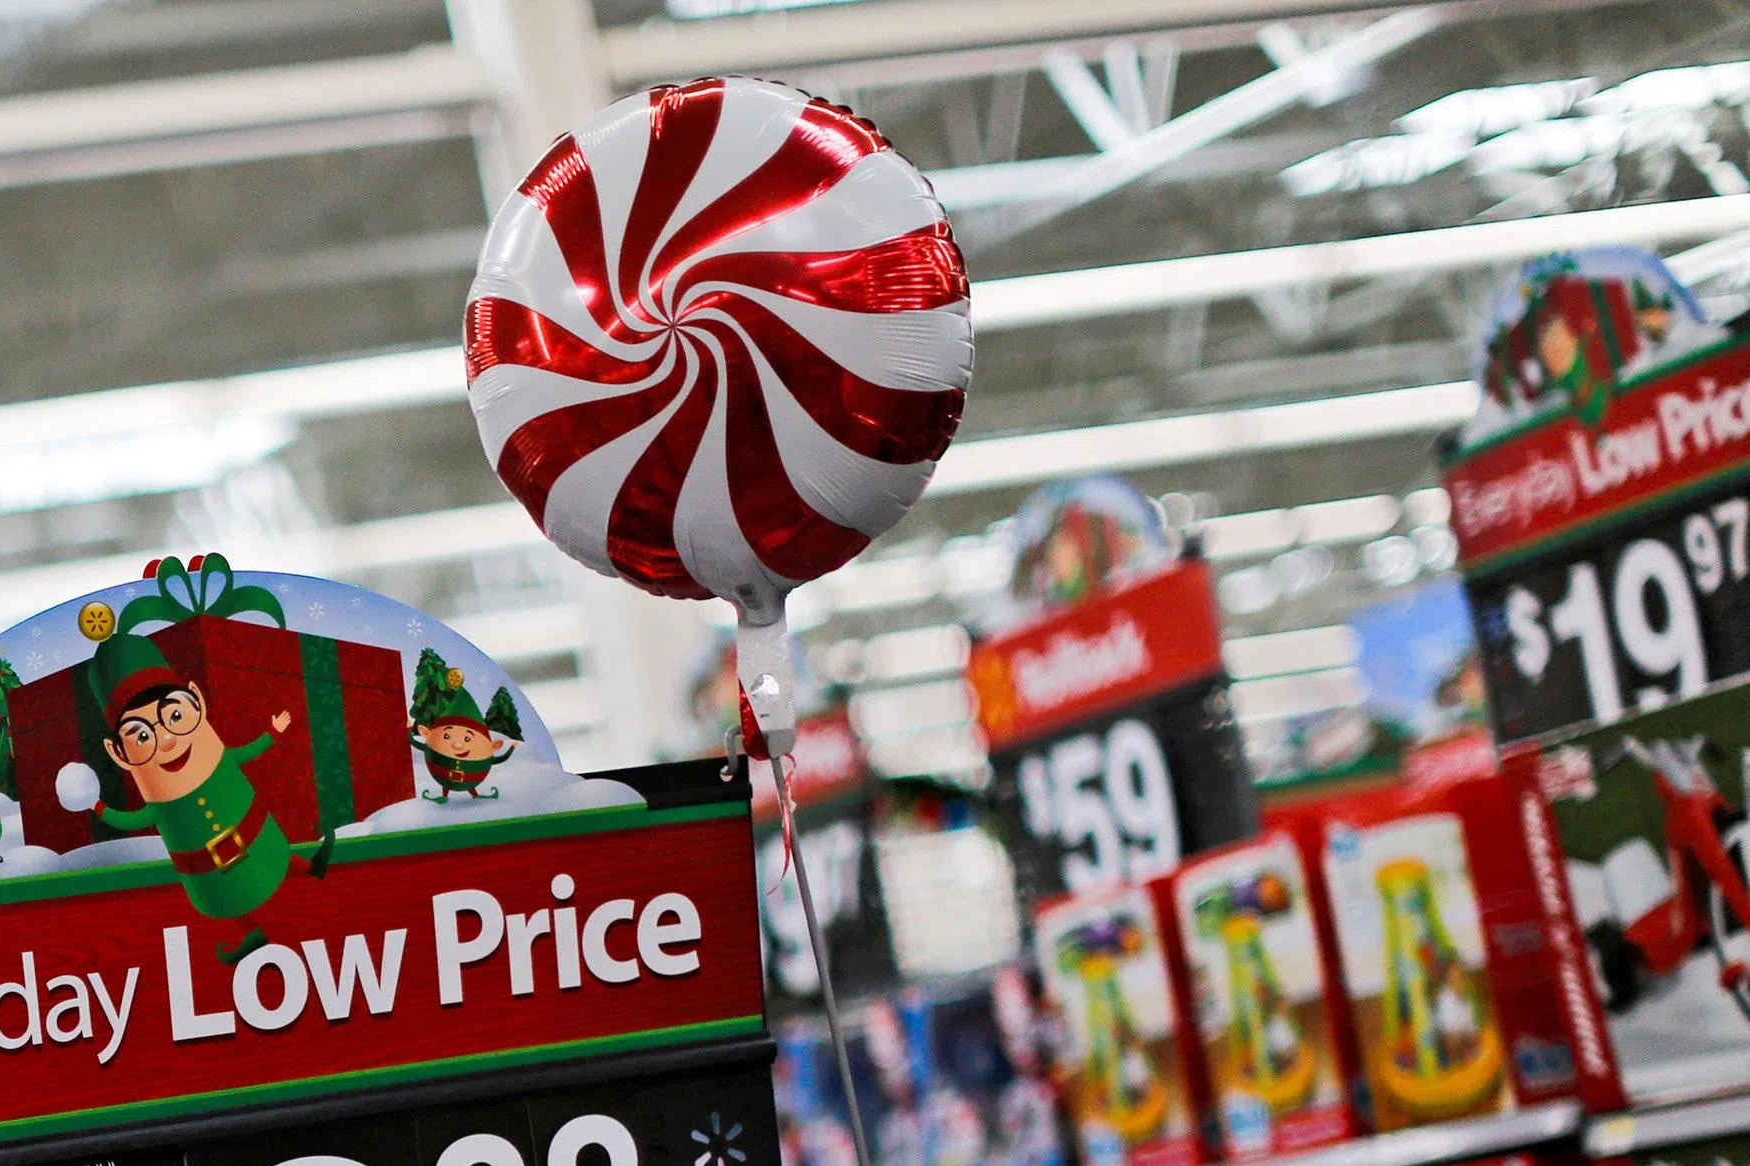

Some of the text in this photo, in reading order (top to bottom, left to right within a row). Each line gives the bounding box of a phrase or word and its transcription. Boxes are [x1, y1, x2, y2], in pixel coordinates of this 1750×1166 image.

[1568, 427, 1662, 496] Low
[1655, 376, 1750, 464] Pric
[1684, 499, 1750, 593] 97
[162, 925, 407, 1041] Low
[432, 873, 702, 1005] Price
